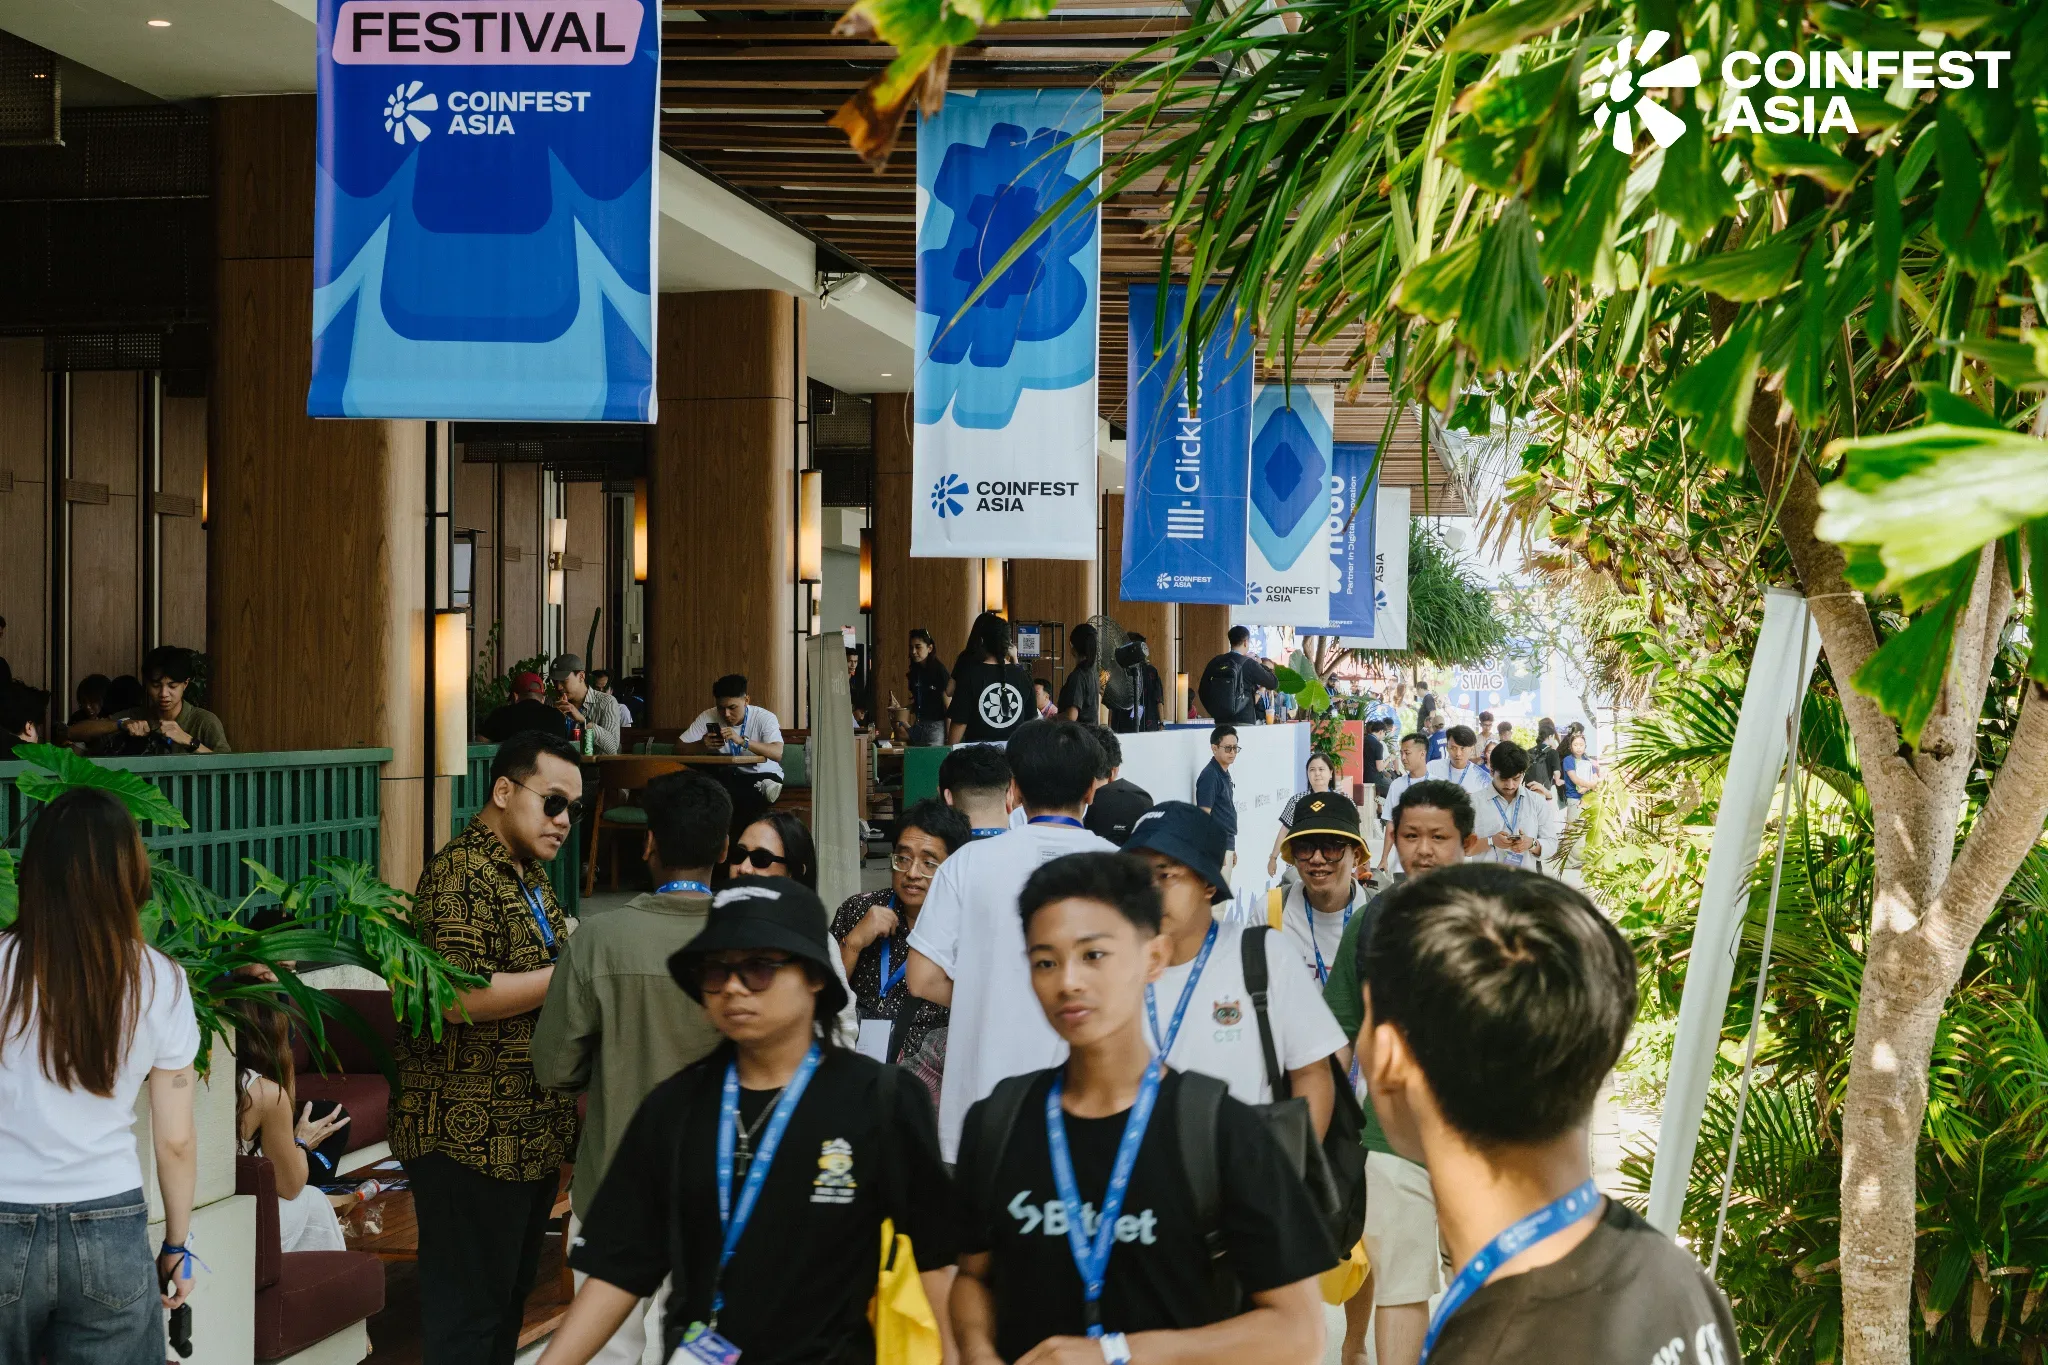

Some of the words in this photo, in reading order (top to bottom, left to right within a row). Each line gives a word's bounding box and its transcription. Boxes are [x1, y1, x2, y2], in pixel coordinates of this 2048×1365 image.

[352, 11, 626, 53] FESTIVAL
[447, 91, 591, 112] COINFEST
[447, 114, 516, 135] ASIA
[976, 481, 1080, 496] COINFEST
[976, 497, 1024, 512] ASIA
[1375, 552, 1385, 583] ASIA
[1173, 575, 1212, 583] COINFEST
[1346, 561, 1354, 595] Partner
[1265, 585, 1320, 595] COINFEST
[1265, 594, 1292, 603] ASIA
[1462, 674, 1503, 690] SWAG
[1043, 1199, 1158, 1247] Btet
